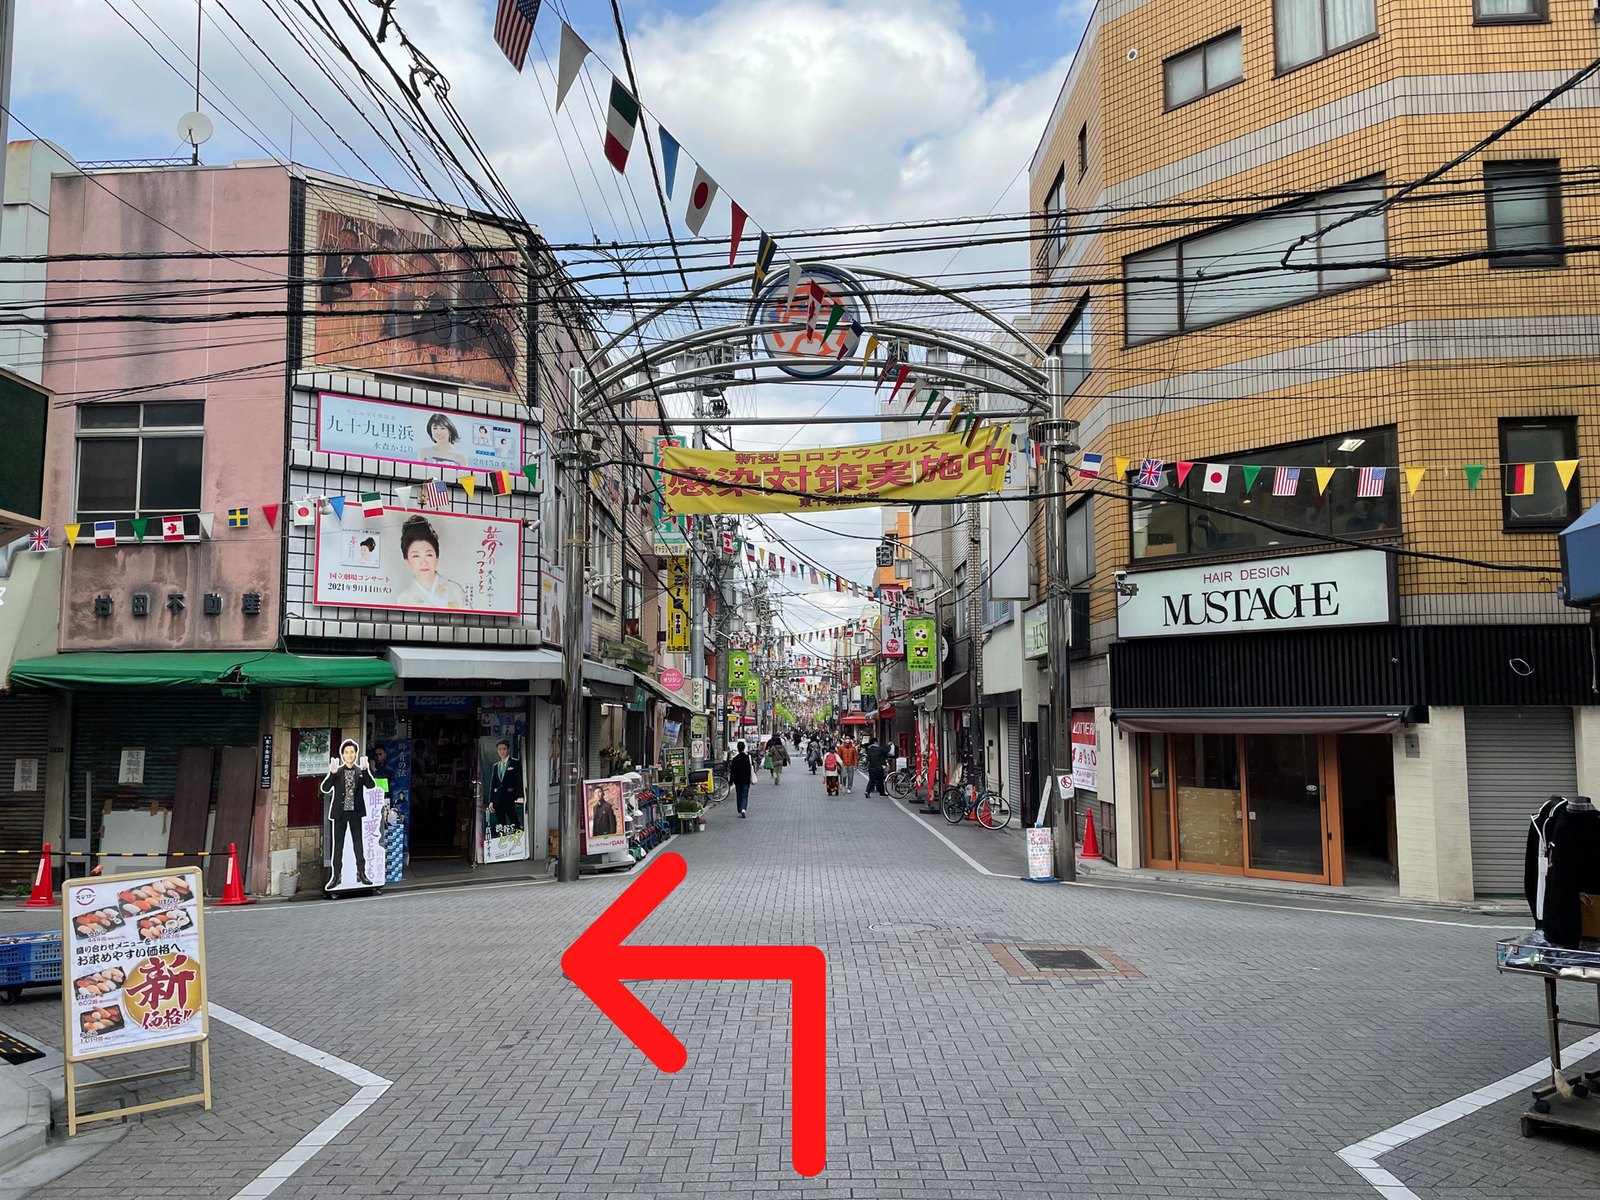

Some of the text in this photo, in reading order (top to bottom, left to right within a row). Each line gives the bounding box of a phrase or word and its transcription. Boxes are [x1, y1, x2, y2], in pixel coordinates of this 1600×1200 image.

[327, 415, 415, 442] 九十九里浜
[734, 440, 941, 465] 新型コロナウイルス
[667, 443, 1007, 498] 感染対策実施中
[1203, 565, 1290, 584] HAIR DESIGN
[1162, 580, 1340, 627] MUSTACHE
[76, 938, 152, 955] 盛り合わせメニューを
[125, 955, 195, 1010] 新
